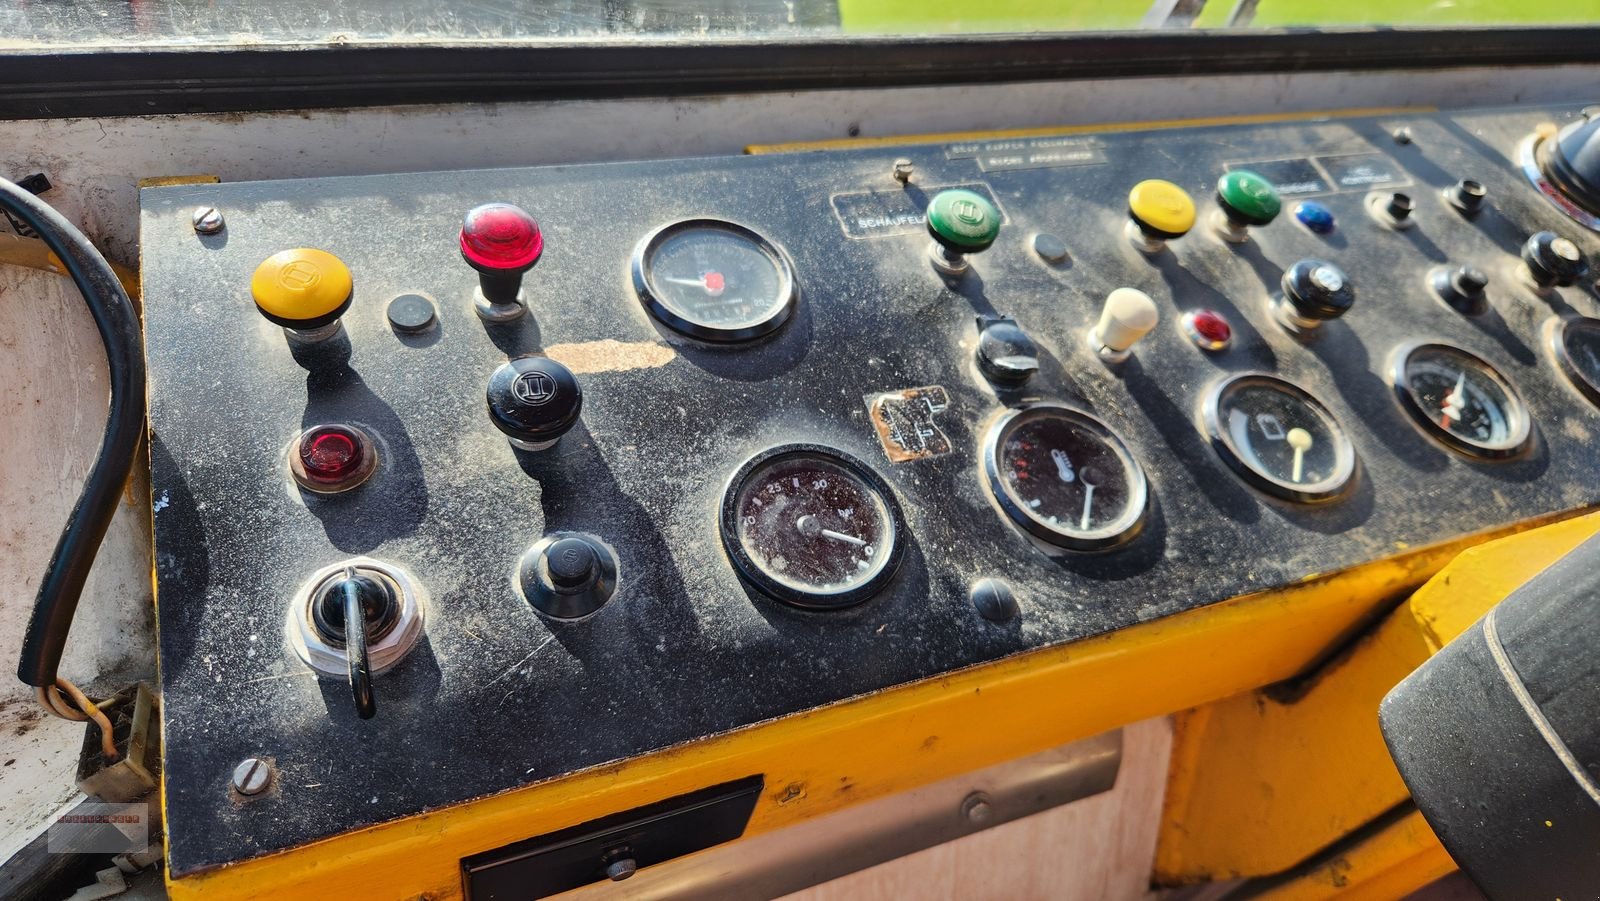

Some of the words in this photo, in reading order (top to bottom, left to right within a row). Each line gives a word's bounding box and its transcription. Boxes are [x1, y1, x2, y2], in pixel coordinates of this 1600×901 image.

[766, 482, 782, 494] 25
[812, 479, 828, 490] 30
[864, 545, 874, 556] 0
